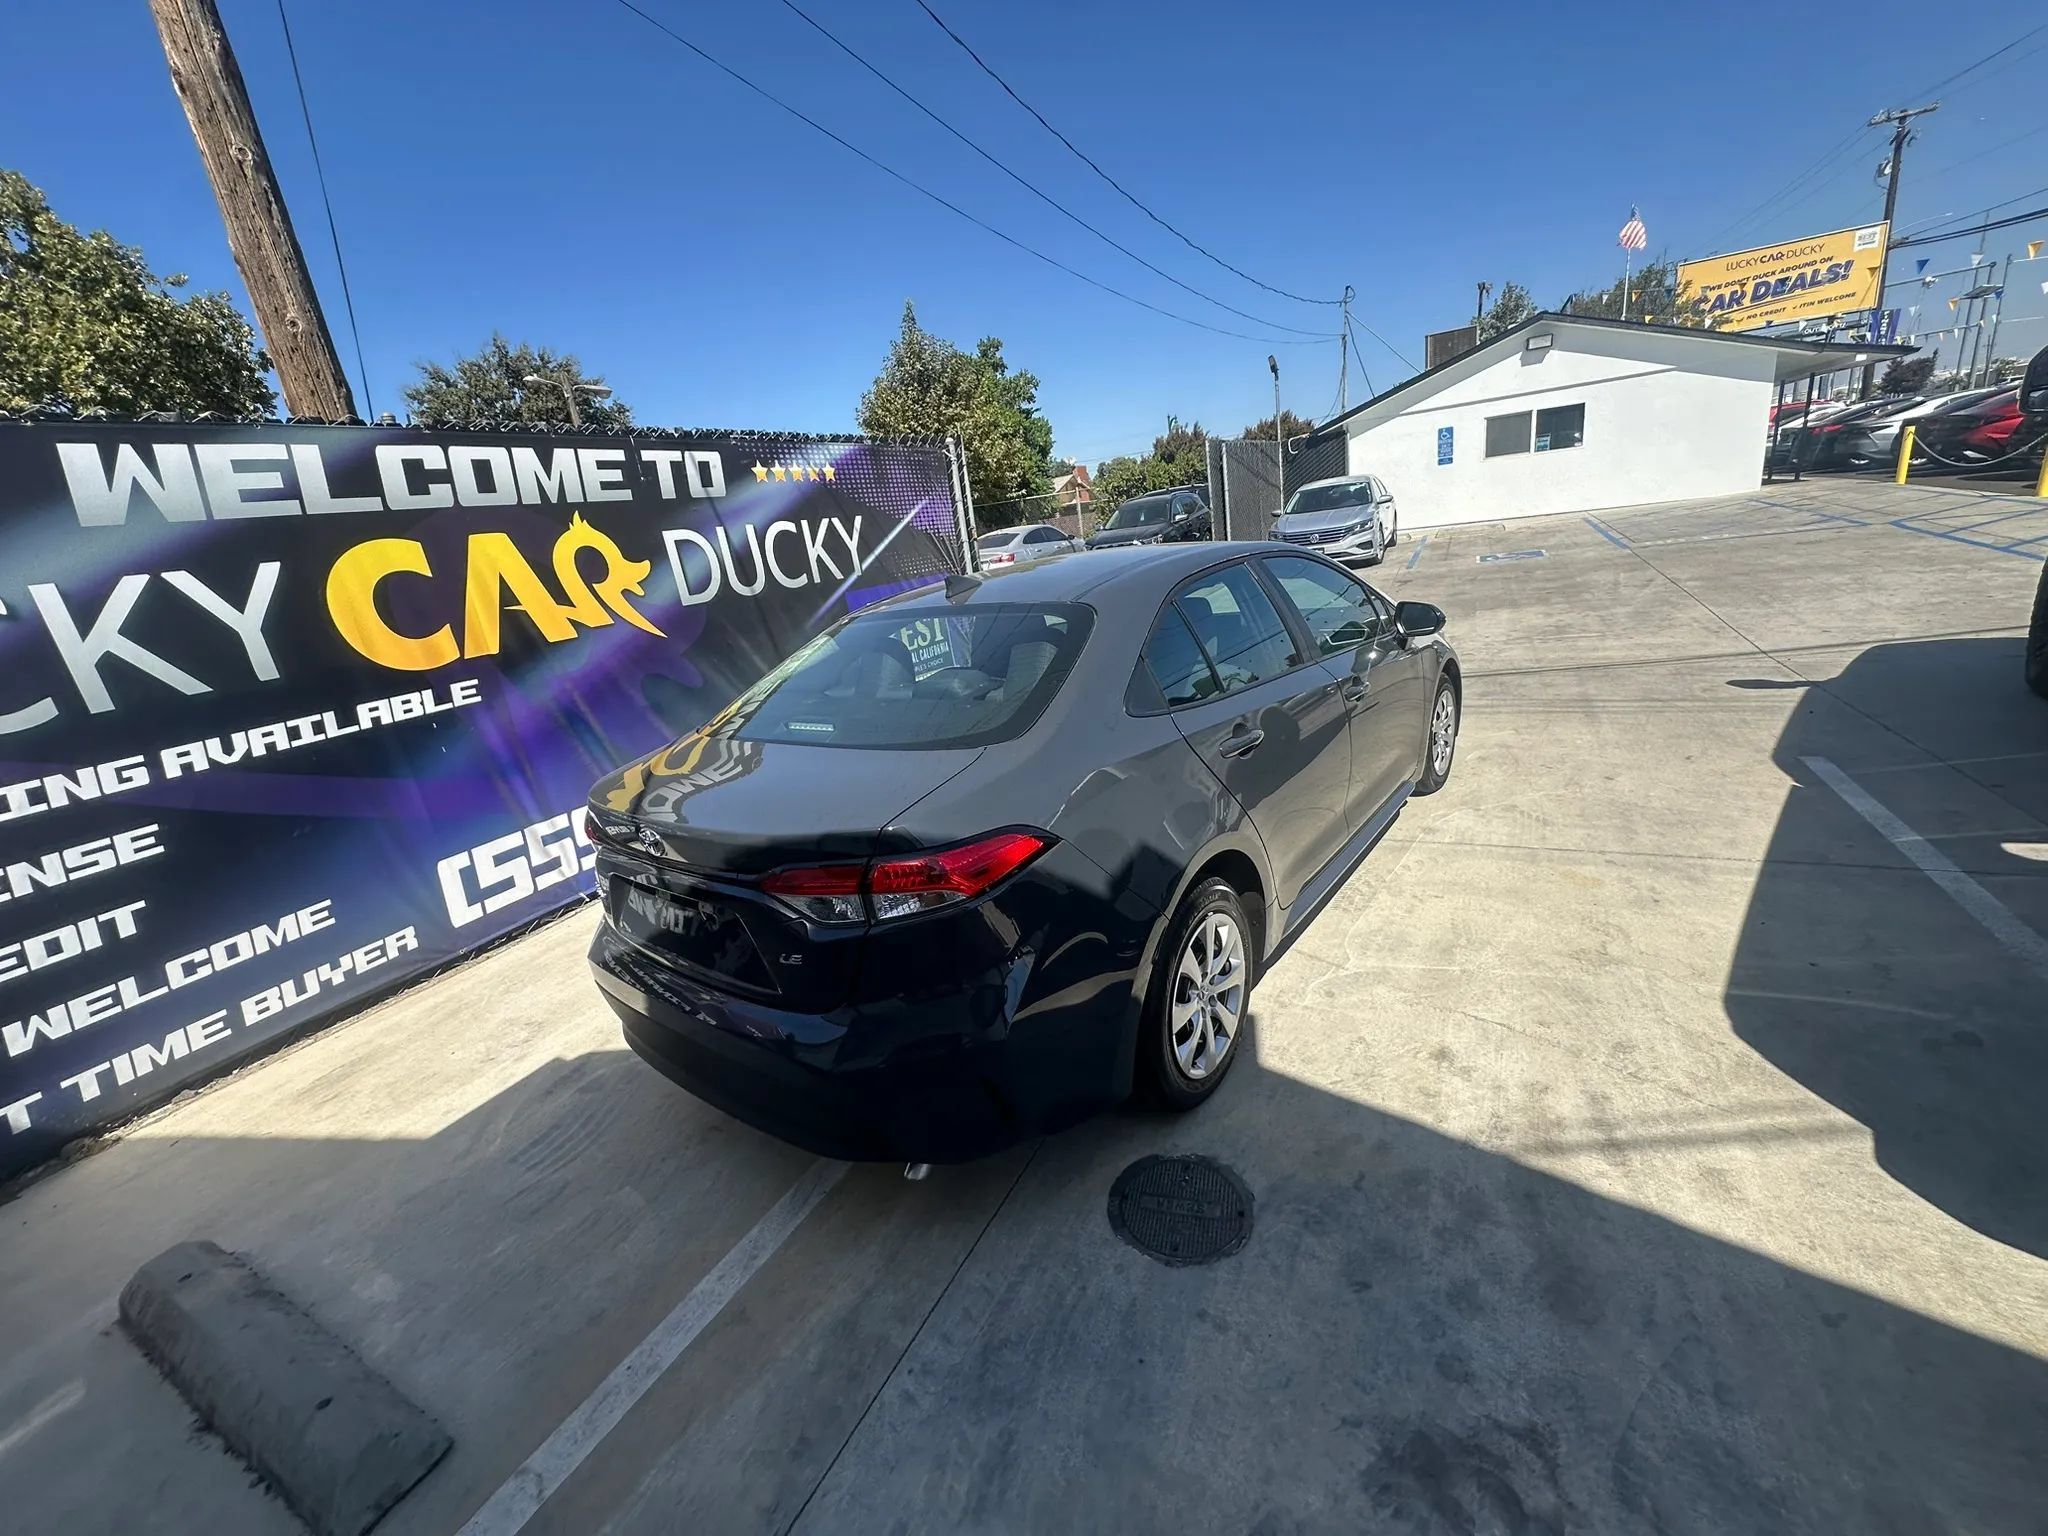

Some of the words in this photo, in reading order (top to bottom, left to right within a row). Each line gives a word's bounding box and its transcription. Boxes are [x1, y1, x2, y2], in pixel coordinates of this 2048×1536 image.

[1690, 289, 1747, 316] CAR
[1750, 259, 1854, 305] DEALS!
[1709, 283, 1723, 291] WE
[1752, 270, 1778, 280] DUCK
[1778, 260, 1818, 275] AROUND
[1819, 256, 1834, 264] ON
[1800, 301, 1816, 309] ITIN
[1817, 292, 1857, 305] WELCOME
[1759, 307, 1787, 317] CREDIT
[56, 442, 632, 526] WELCOME
[639, 449, 727, 498] TO
[326, 510, 668, 671] CAR
[662, 515, 862, 606] DUCKY
[161, 679, 482, 779] AVAILABLE
[2, 899, 336, 1058] WELCOME
[780, 953, 802, 965] LE
[60, 1009, 232, 1102] TIME
[241, 925, 420, 1028] BUYER
